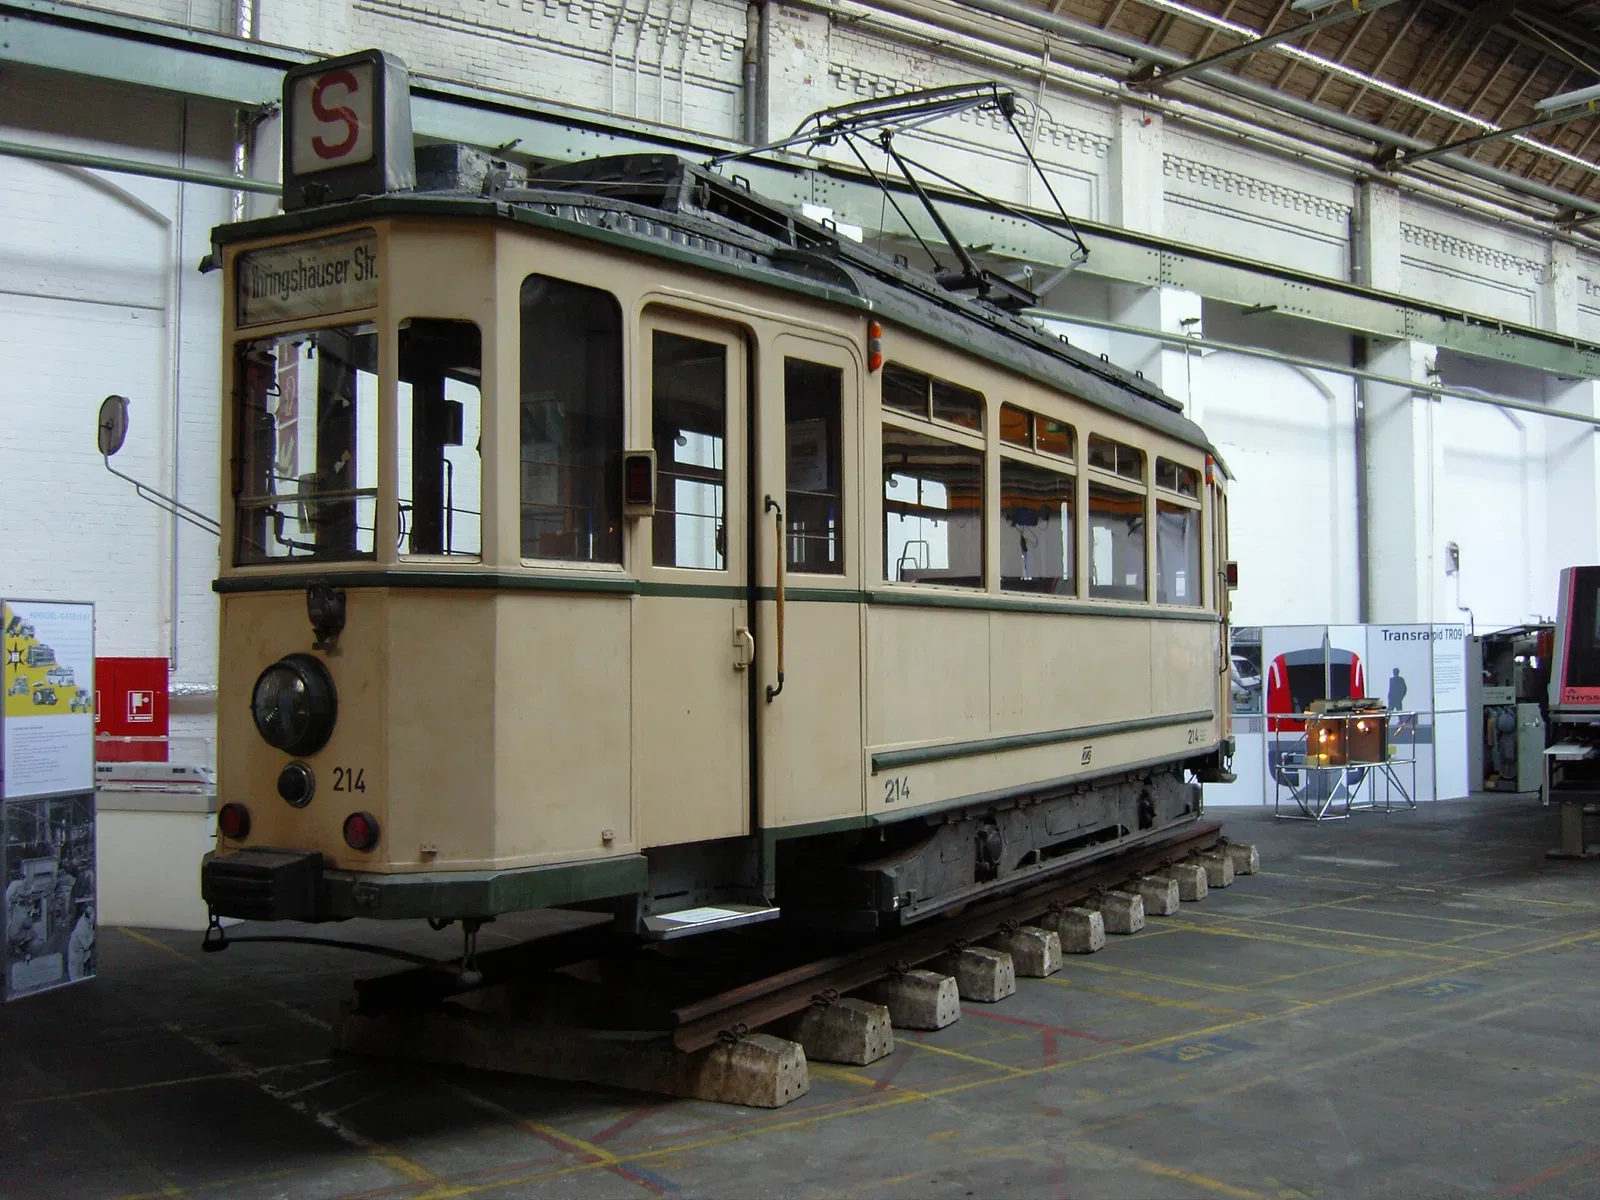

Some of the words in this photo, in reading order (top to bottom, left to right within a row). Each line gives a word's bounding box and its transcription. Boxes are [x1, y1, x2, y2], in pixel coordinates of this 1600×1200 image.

[311, 69, 360, 160] S
[252, 256, 351, 301] Ihringshäuser
[354, 245, 378, 281] Str.
[1444, 628, 1462, 640] TR09
[1187, 728, 1199, 744] 214
[333, 766, 366, 793] 214
[885, 776, 910, 803] 214
